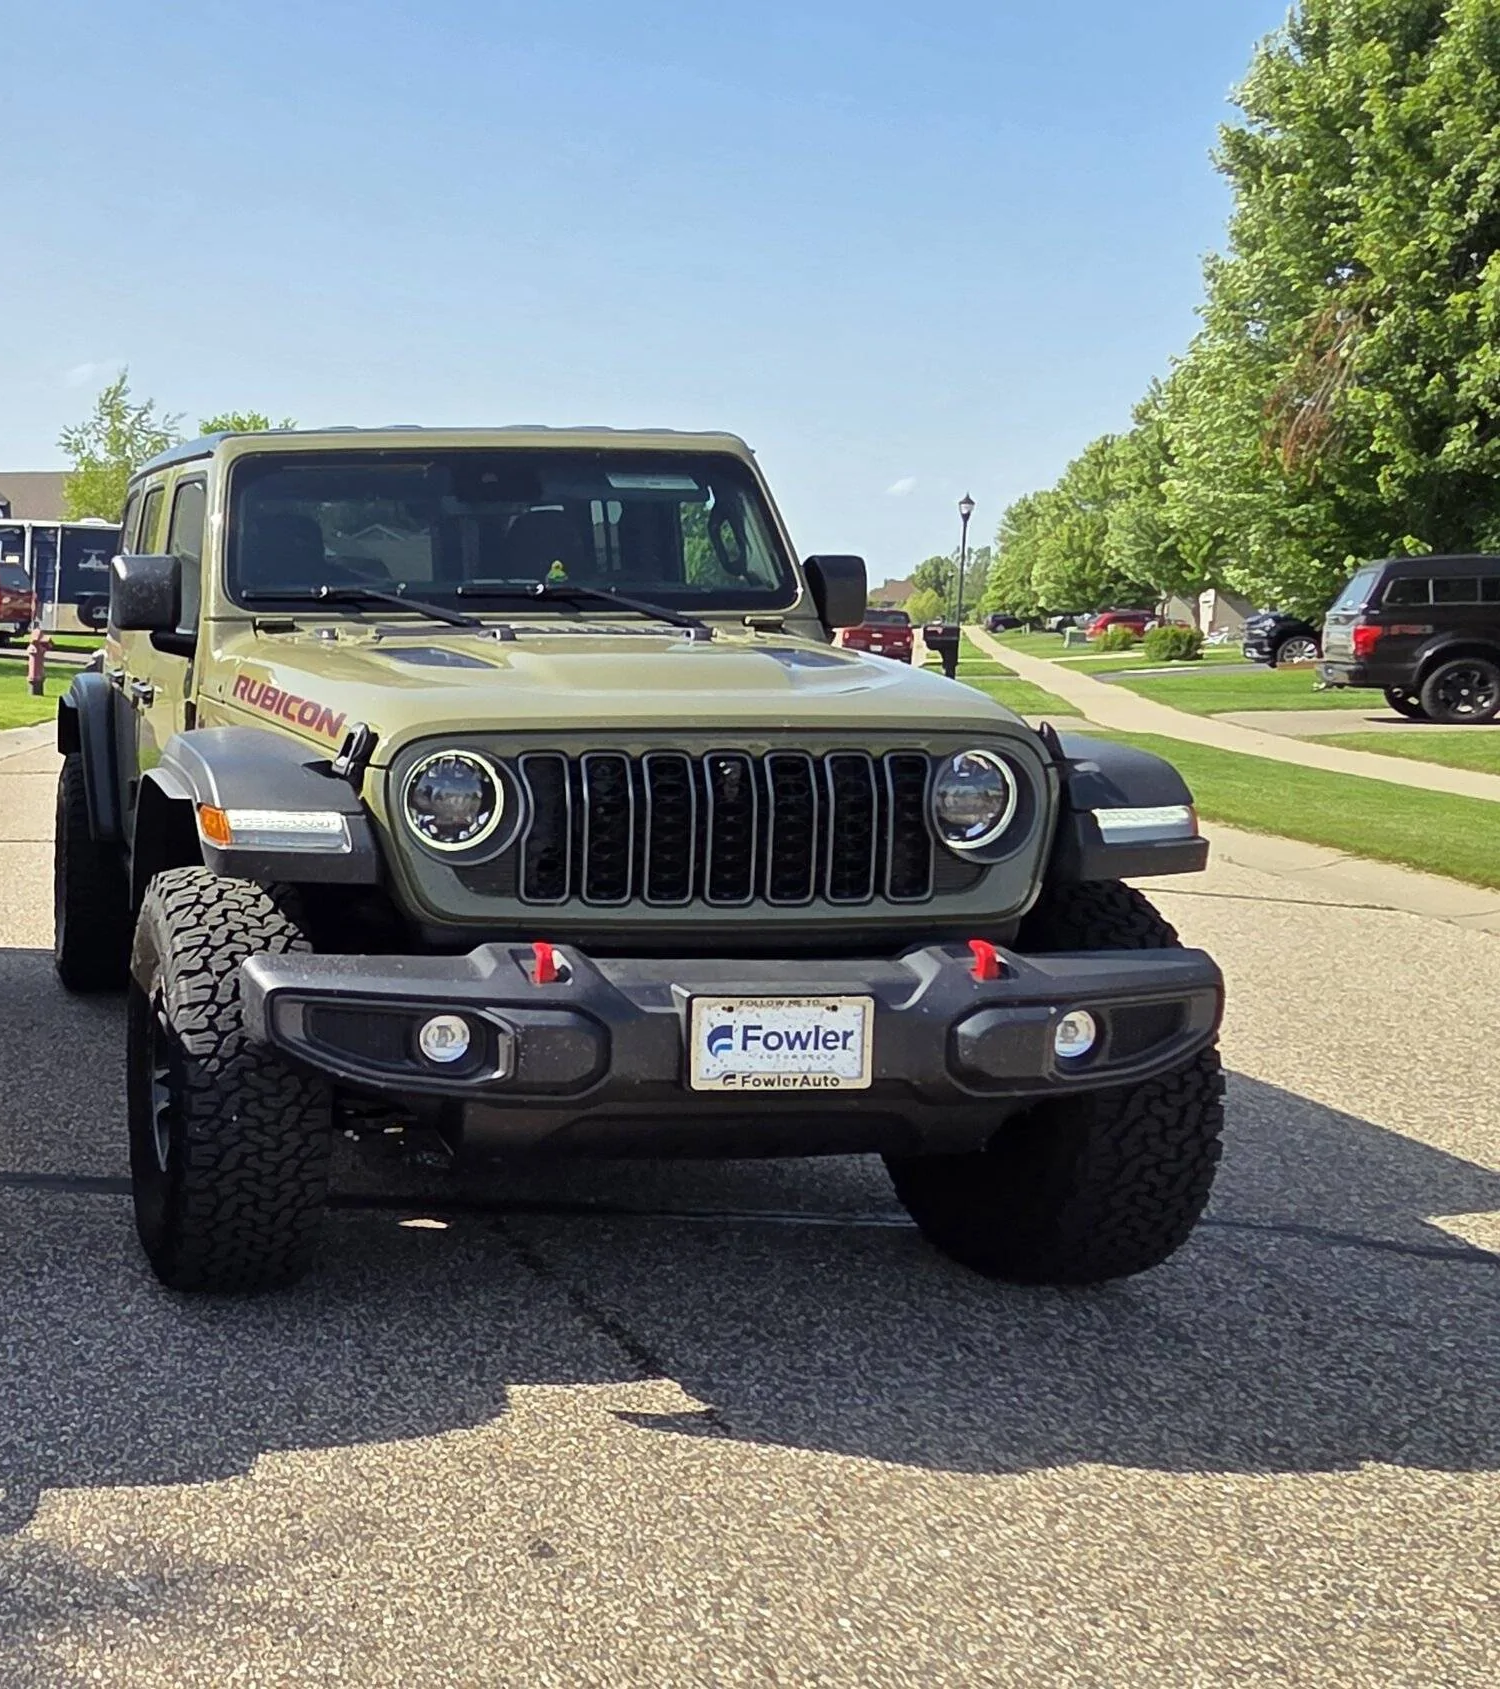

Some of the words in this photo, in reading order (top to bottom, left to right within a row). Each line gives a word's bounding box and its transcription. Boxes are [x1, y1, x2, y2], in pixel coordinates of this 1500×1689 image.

[233, 675, 348, 738] RUBICON
[741, 1025, 854, 1051] Fowler
[741, 1075, 840, 1087] FowlerAuto
